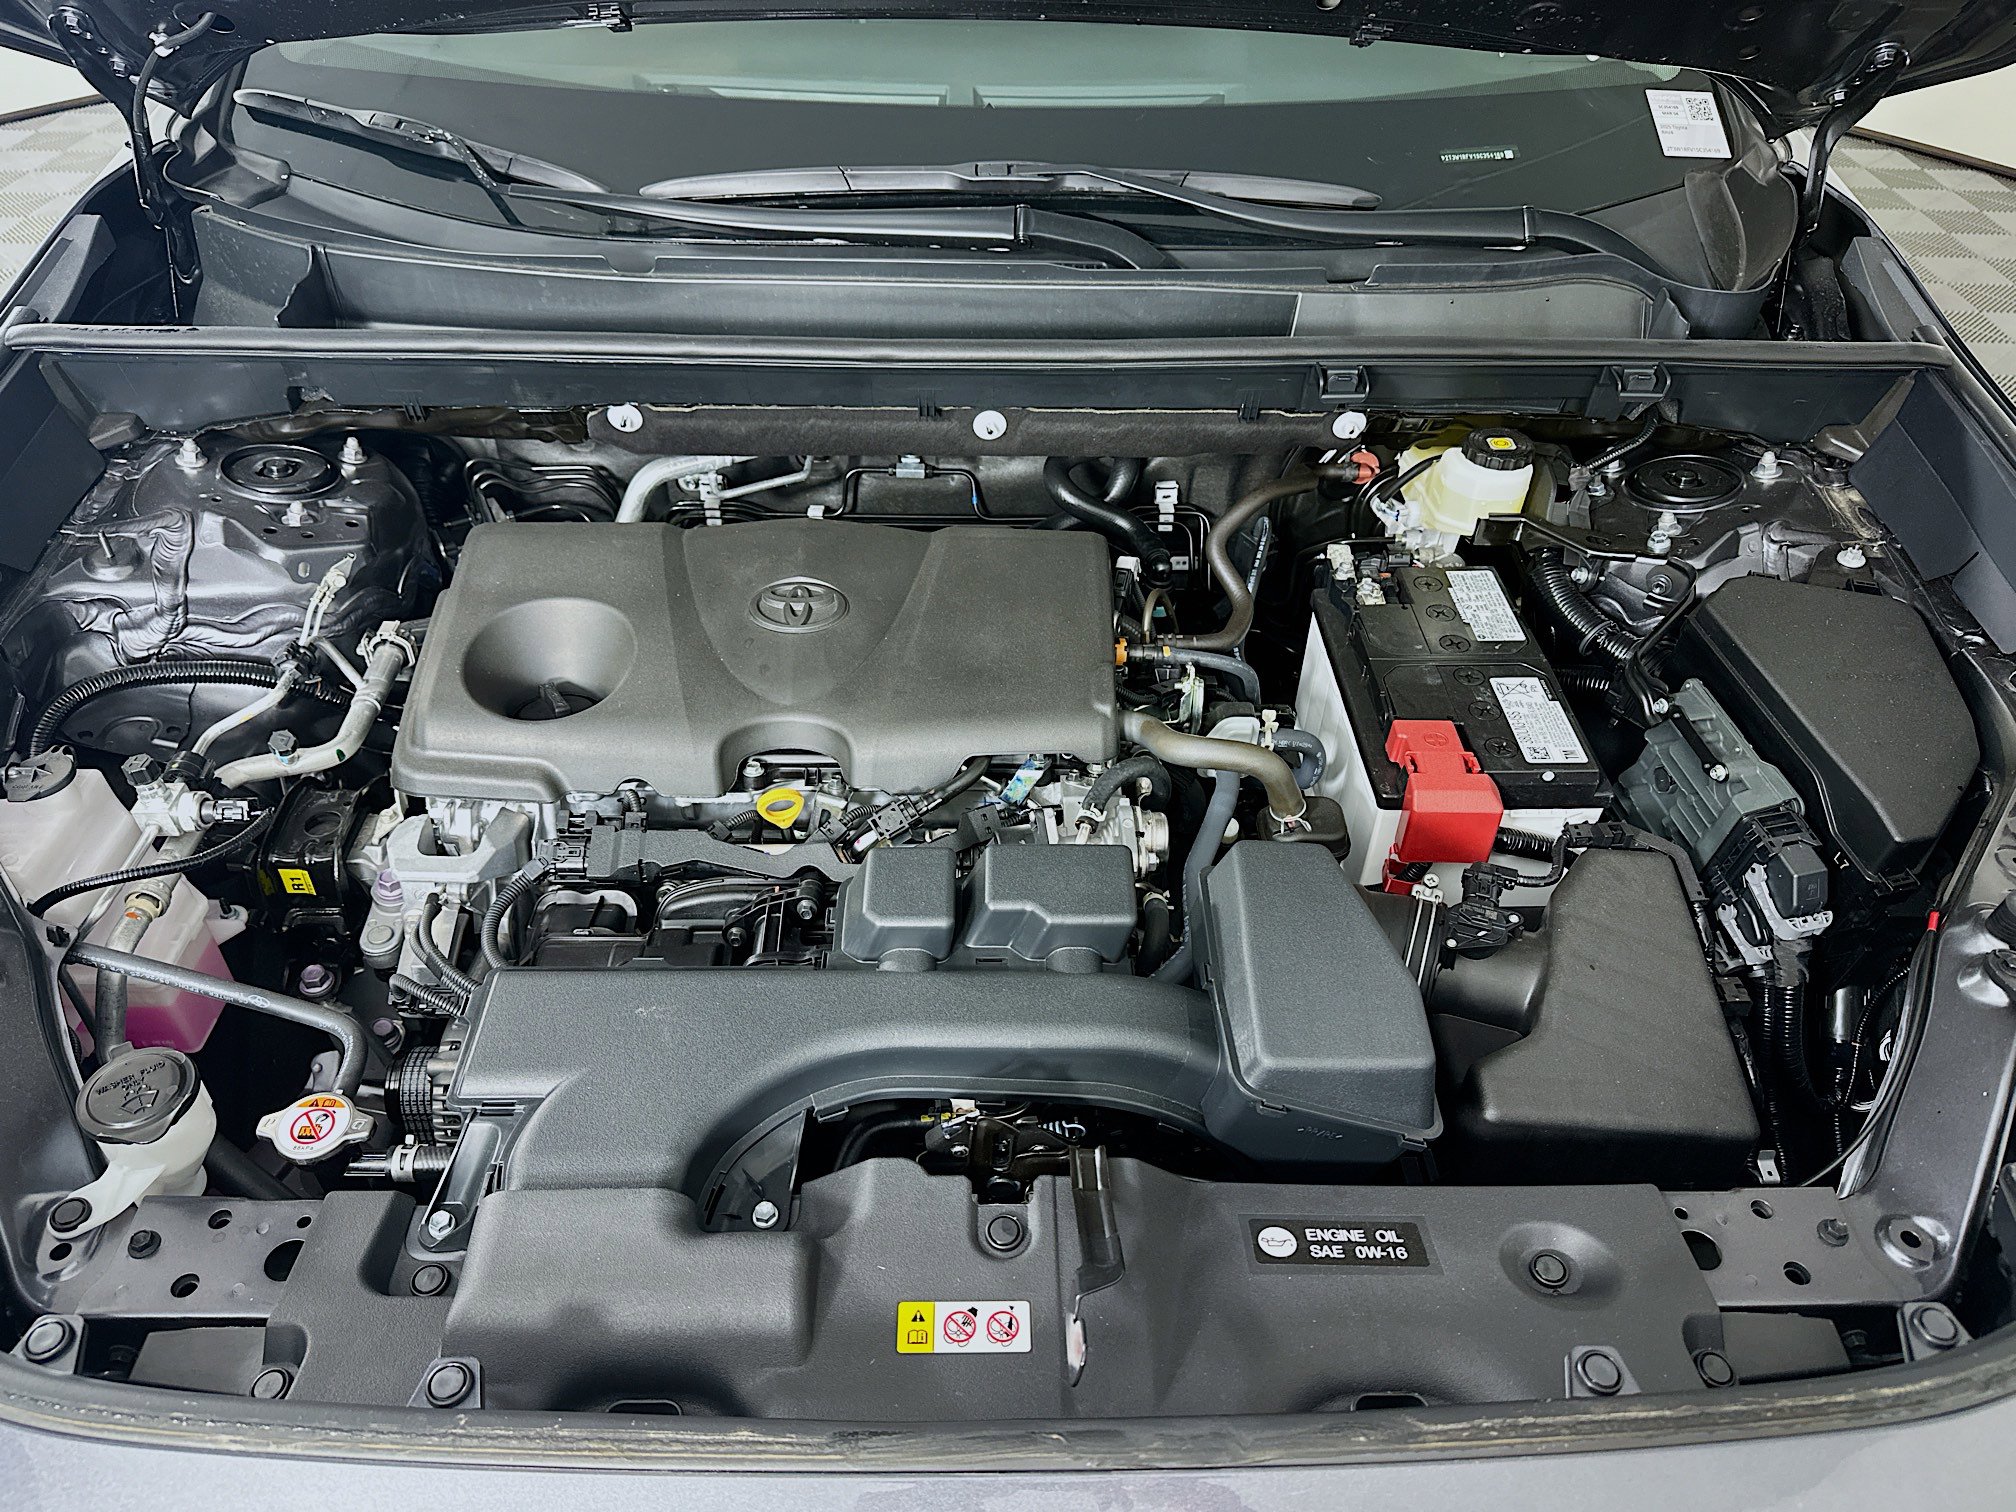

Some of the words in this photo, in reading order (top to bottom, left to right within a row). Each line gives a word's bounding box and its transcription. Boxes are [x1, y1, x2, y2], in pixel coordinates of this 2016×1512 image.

[1833, 851, 1850, 870] L7
[289, 877, 306, 891] R1
[96, 1073, 135, 1095] WASHER
[139, 1060, 166, 1076] FLUID
[1304, 1228, 1366, 1242] ENGINE
[1374, 1229, 1404, 1243] OIL
[1310, 1245, 1345, 1259] SAE
[1355, 1246, 1409, 1260] 0W-16
